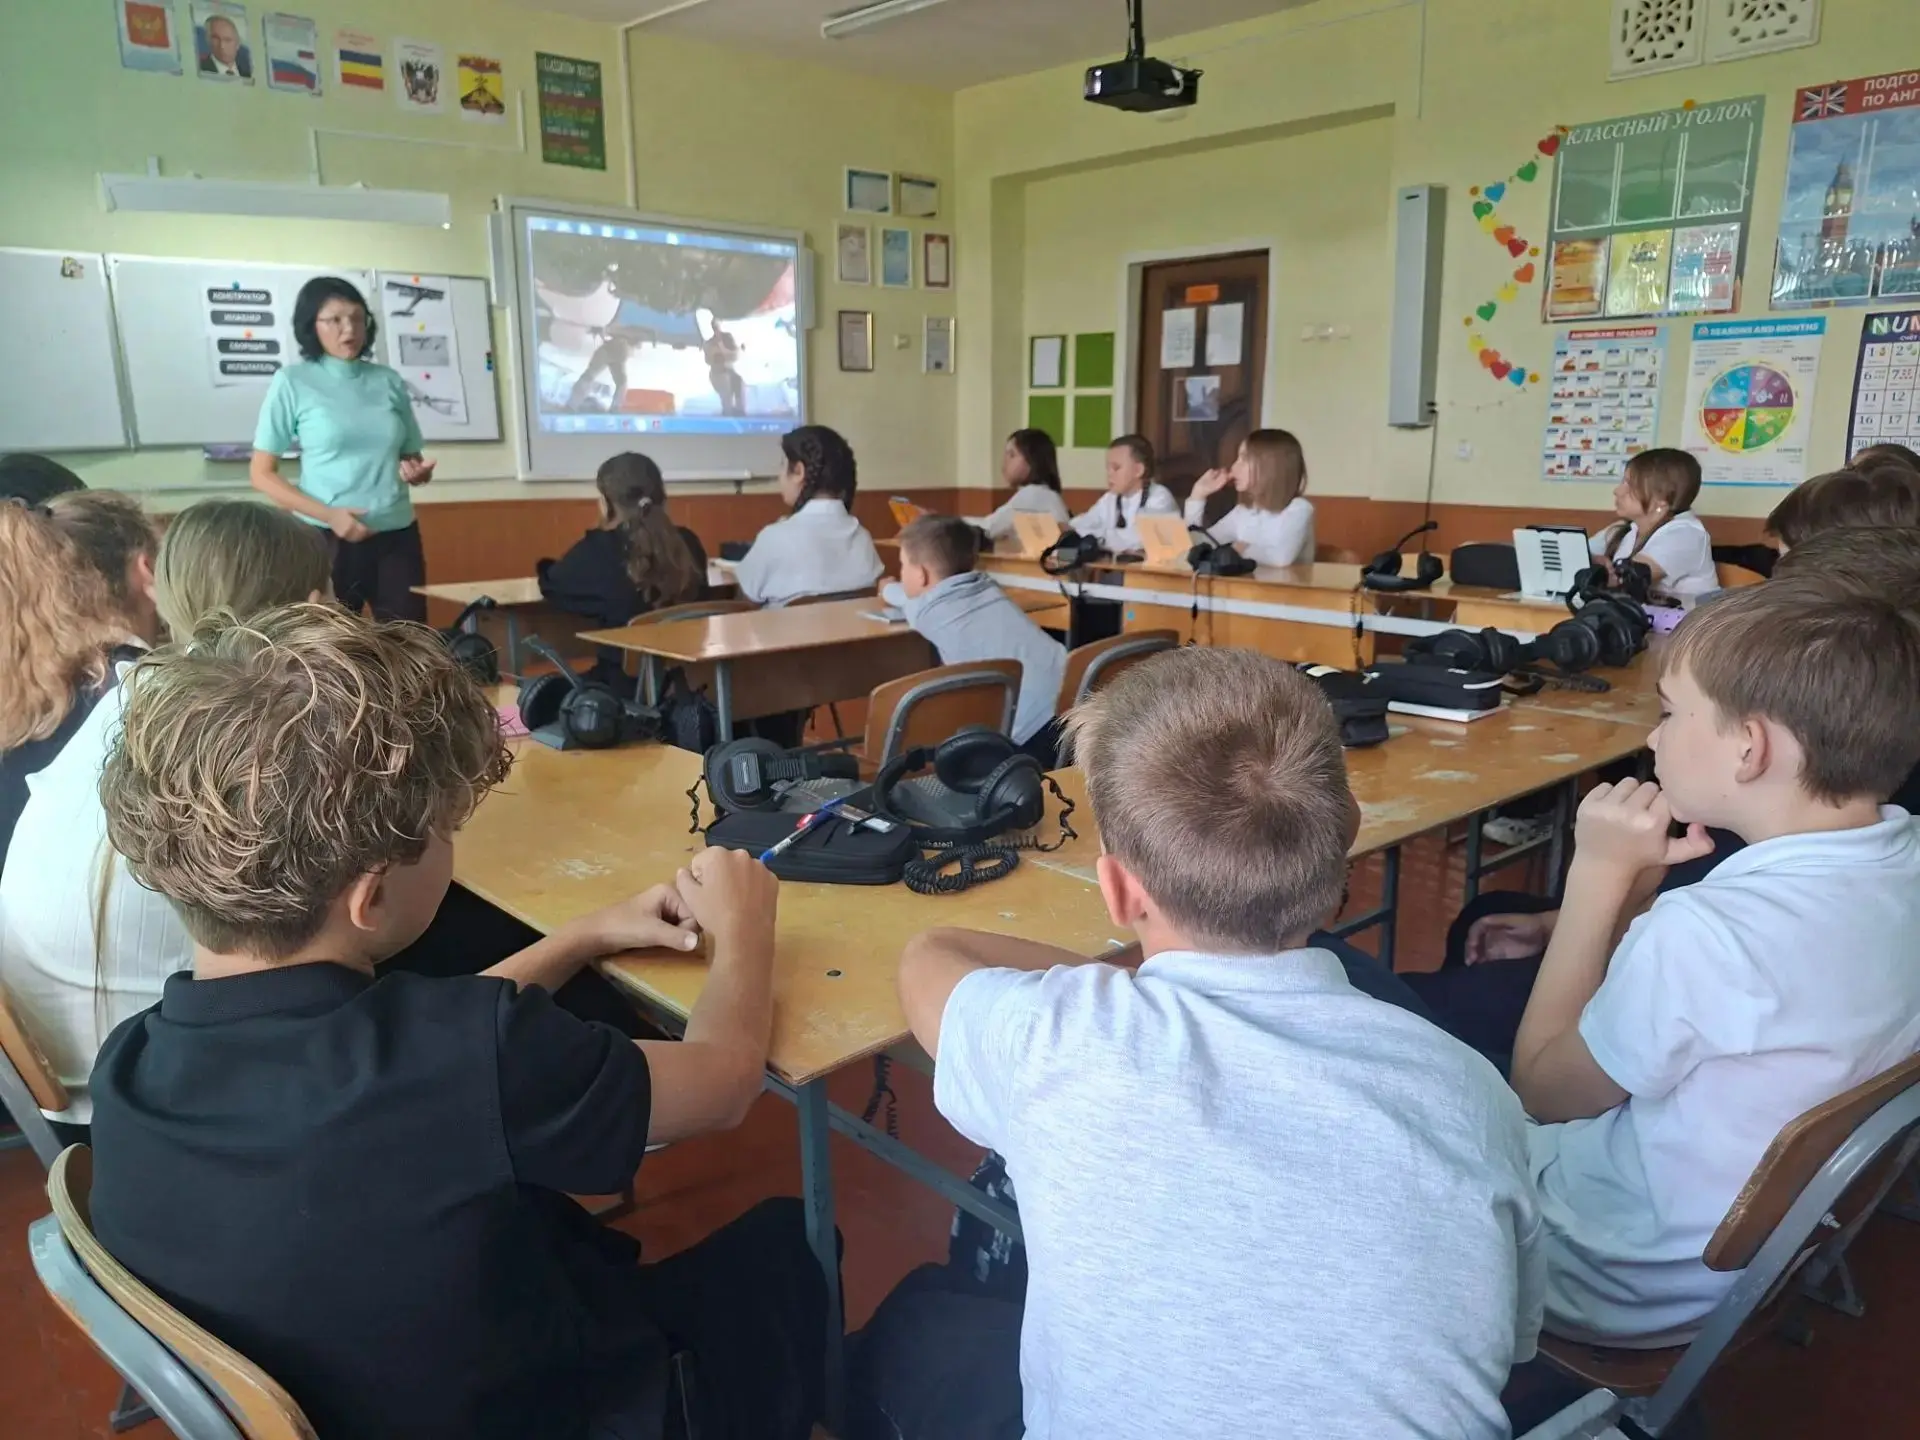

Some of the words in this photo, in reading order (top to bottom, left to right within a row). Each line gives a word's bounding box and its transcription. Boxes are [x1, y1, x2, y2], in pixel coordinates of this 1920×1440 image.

[1864, 73, 1919, 91] ПОДГО
[1862, 94, 1885, 107] ПО
[1566, 111, 1669, 146] КЛАССНЫЙ
[1672, 100, 1757, 128] УГОЛОК
[1753, 325, 1774, 333] AND
[1868, 347, 1875, 357] 1
[1896, 346, 1904, 356] 2
[1863, 371, 1872, 380] 6
[1892, 369, 1900, 380] 7
[1864, 393, 1877, 402] 11
[1891, 392, 1905, 401] 12
[1859, 415, 1873, 424] 16
[1888, 415, 1902, 424] 17
